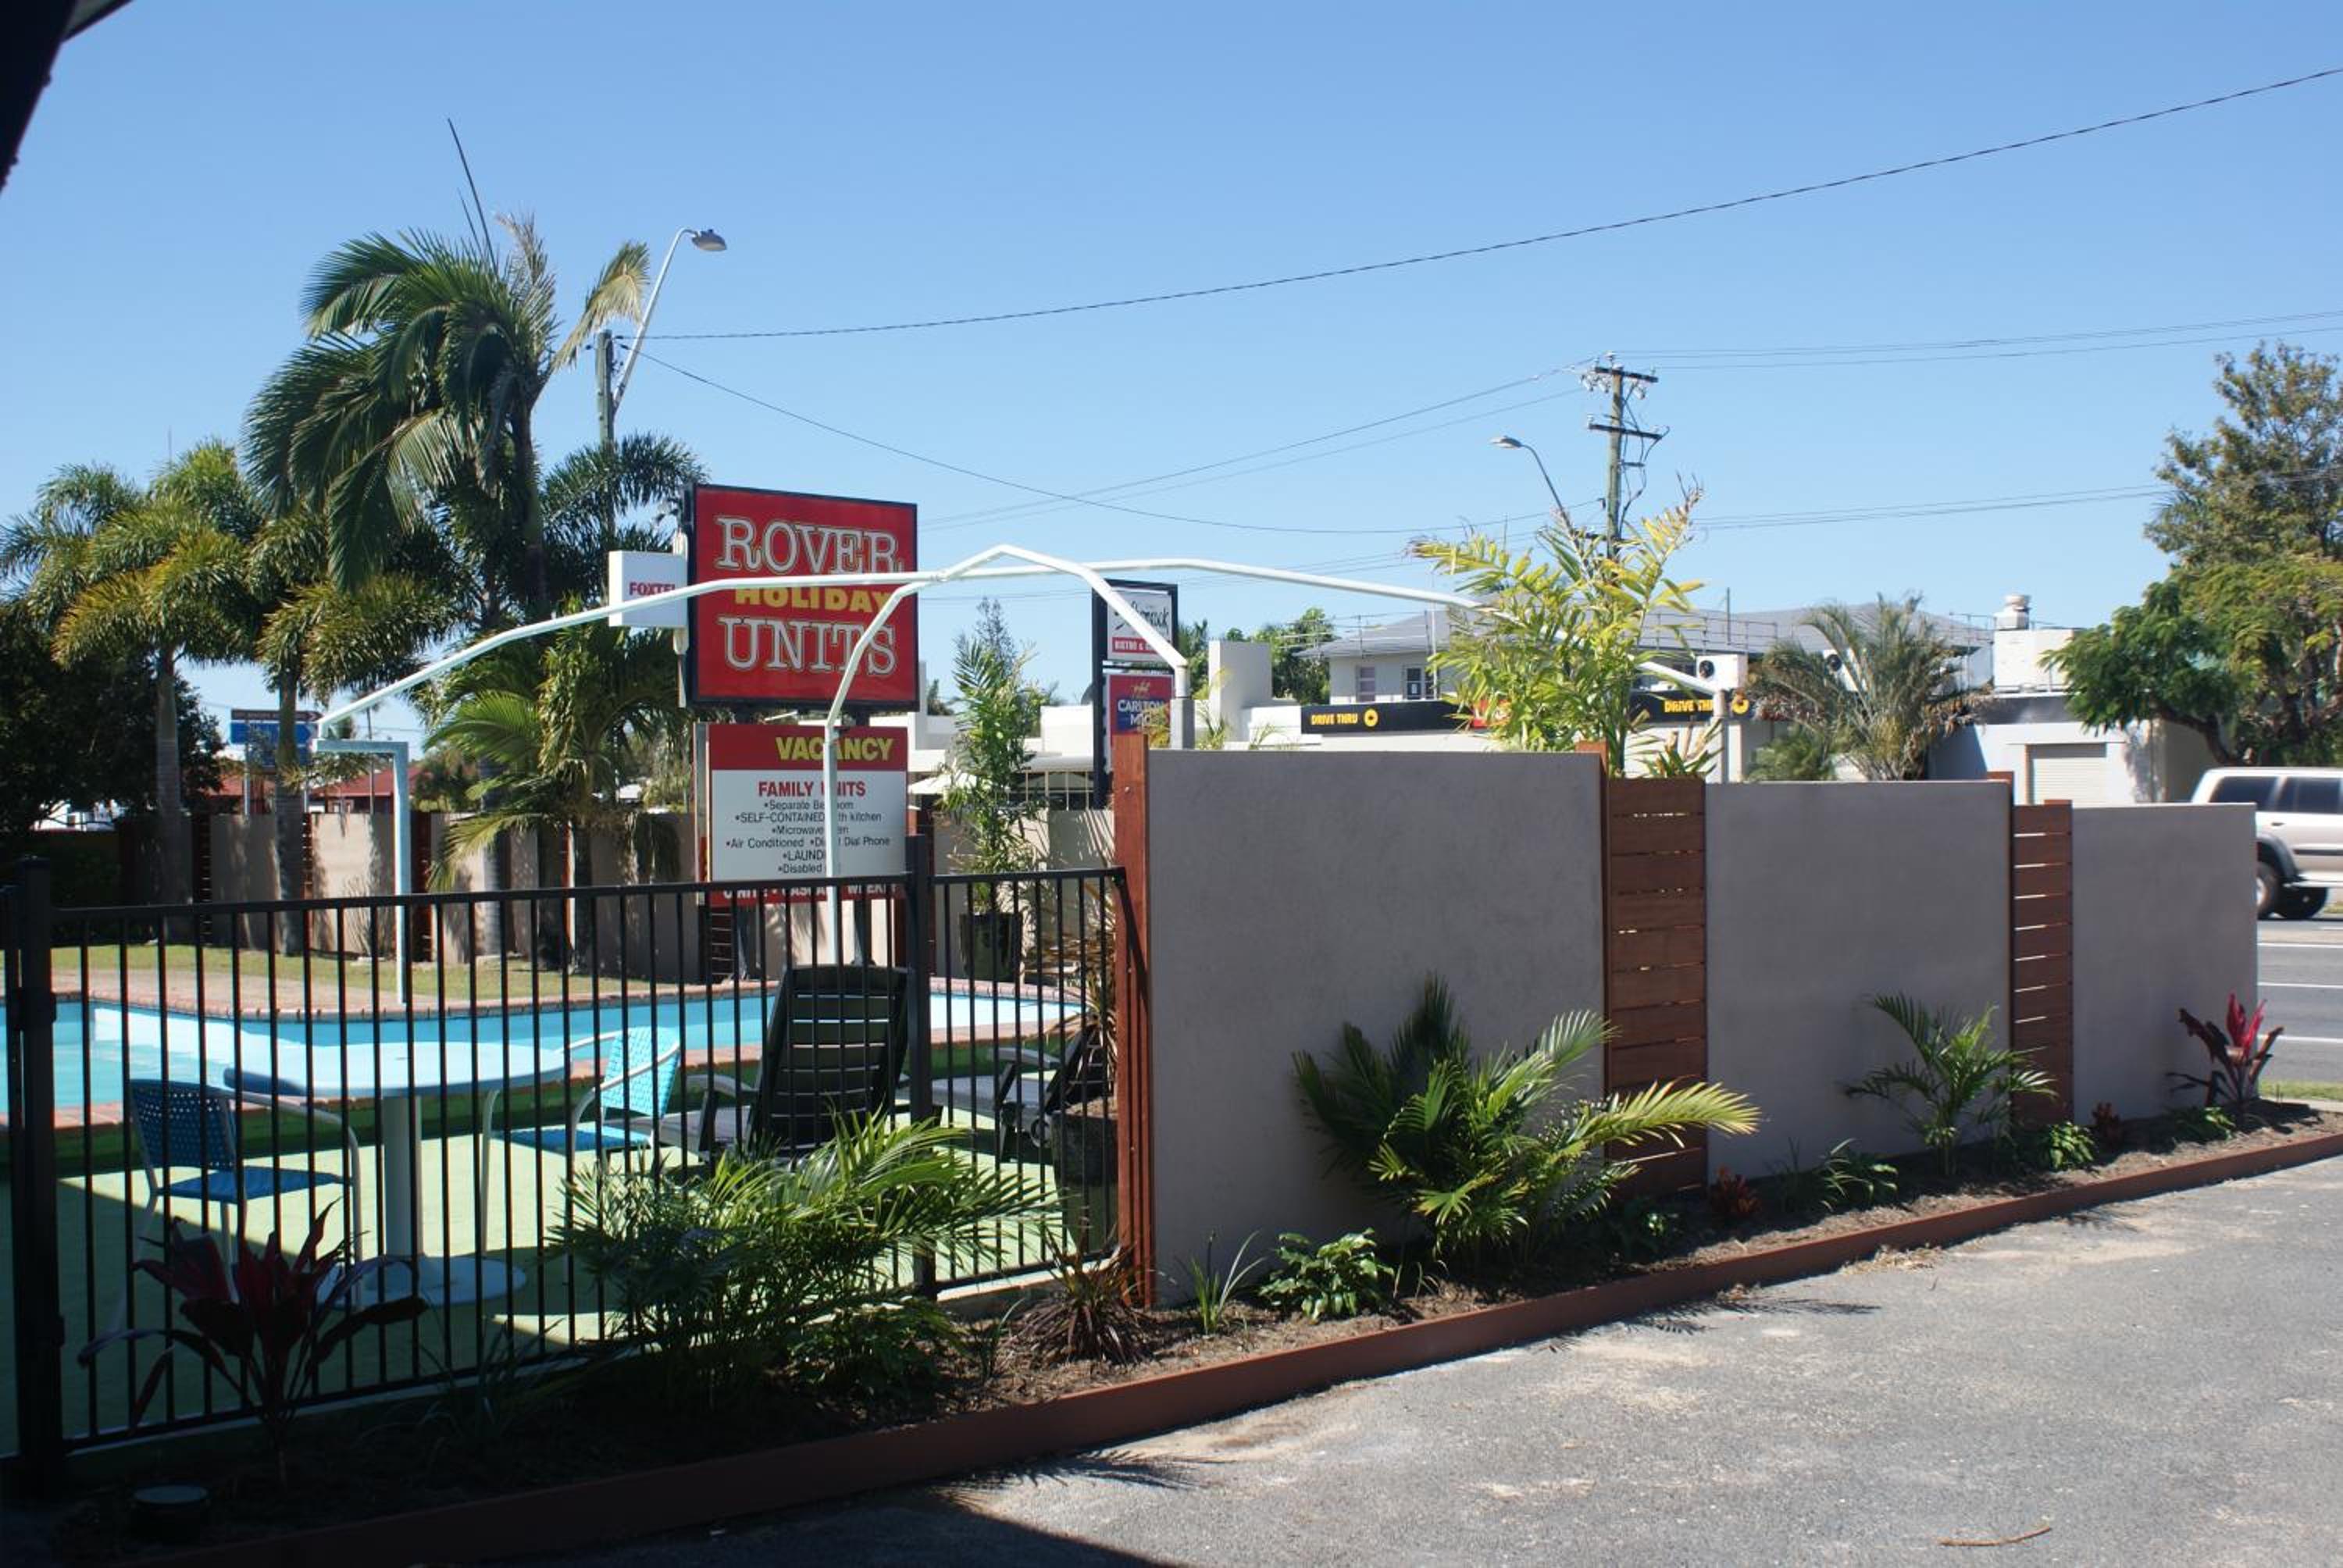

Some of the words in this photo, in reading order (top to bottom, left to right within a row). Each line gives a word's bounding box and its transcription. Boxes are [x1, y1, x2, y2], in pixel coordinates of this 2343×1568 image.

[715, 516, 904, 575] ROVER
[717, 615, 897, 676] UNITS
[1664, 700, 1694, 713] DRIVE
[1311, 714, 1335, 725] DRIVE
[1336, 712, 1358, 725] THRU
[758, 781, 814, 797] FAMILY
[769, 800, 810, 811] Separate
[850, 812, 882, 821] kitchen
[776, 825, 825, 835] Microwave
[731, 838, 744, 848] Air
[747, 838, 804, 848] Conditioned
[844, 836, 861, 846] Dial
[863, 836, 890, 846] Phone
[783, 864, 822, 874] Disabled
